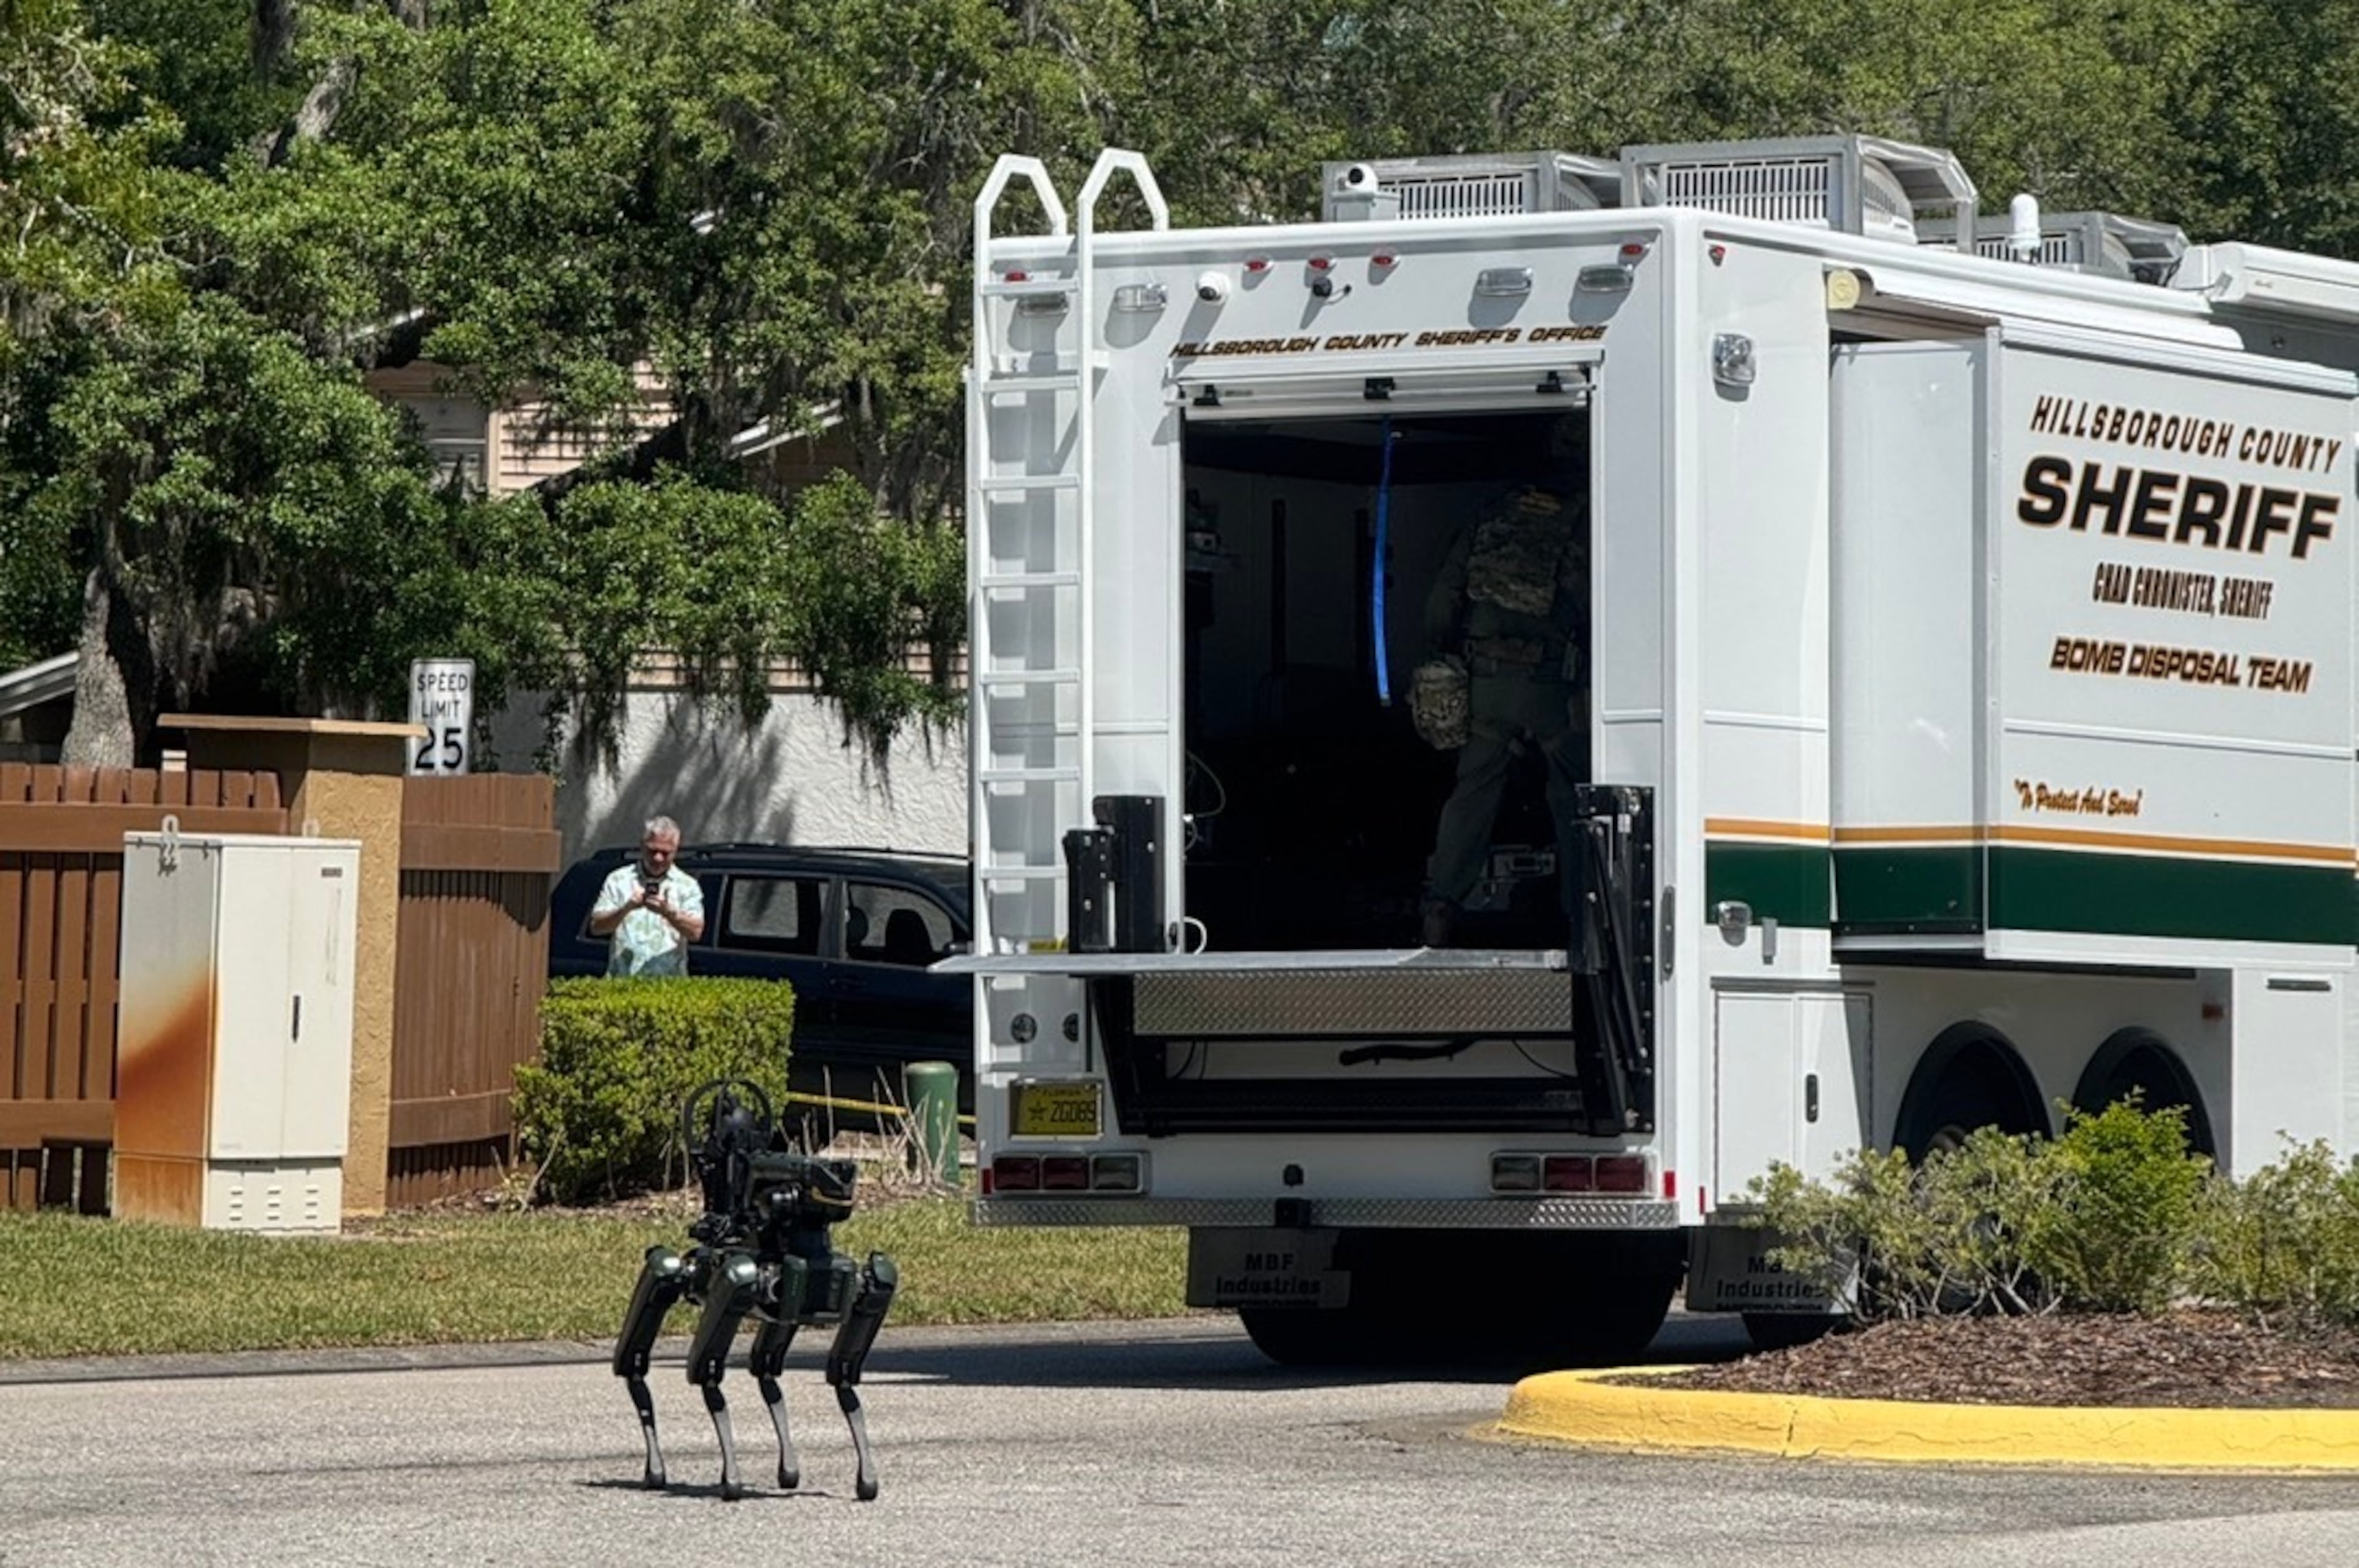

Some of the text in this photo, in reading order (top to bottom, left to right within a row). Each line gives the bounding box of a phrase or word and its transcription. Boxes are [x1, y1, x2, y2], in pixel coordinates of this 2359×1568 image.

[1168, 326, 1608, 357] HILLSBOROUGH COUNTY SHERIFF'S OFFICE
[2030, 395, 2342, 474] HILLSBOROUGH COUNTY
[2017, 454, 2341, 560] SHERIFF
[2093, 561, 2132, 604] CHAD
[2220, 576, 2274, 619] SHERIFF
[417, 673, 468, 691] SPEED
[2051, 636, 2312, 693] BOMB DISPOSAL TEAM
[422, 700, 460, 717] LIMIT
[415, 727, 463, 769] 25
[1245, 1253, 1294, 1271] MBF
[1216, 1276, 1321, 1294] Industries
